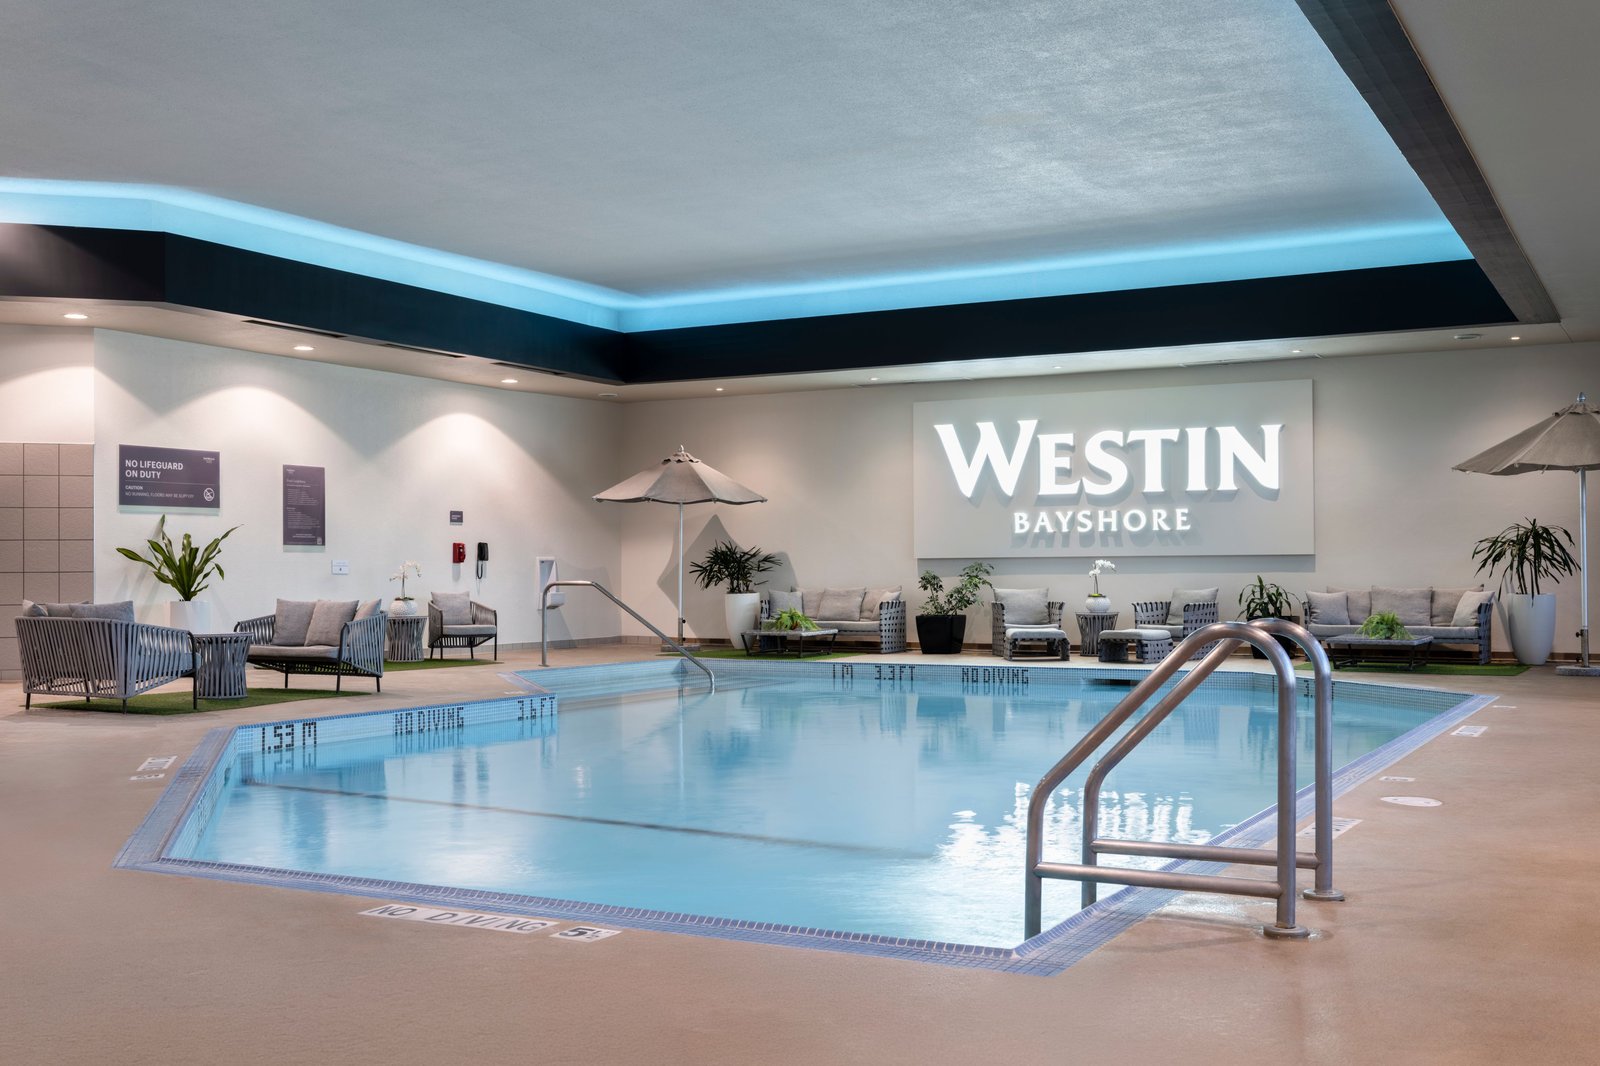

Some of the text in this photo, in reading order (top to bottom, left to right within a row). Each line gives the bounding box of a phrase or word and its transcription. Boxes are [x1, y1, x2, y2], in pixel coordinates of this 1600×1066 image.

[125, 459, 184, 471] NO LIFEGUARD
[934, 419, 1284, 498] WESTIN
[125, 469, 161, 479] ON DUTY
[1013, 507, 1192, 534] BAYSHORE
[961, 667, 1030, 685] NO DIVING
[394, 706, 464, 736] NO DIVING
[262, 721, 317, 752] 1.53 M
[369, 905, 549, 931] NO DIVING
